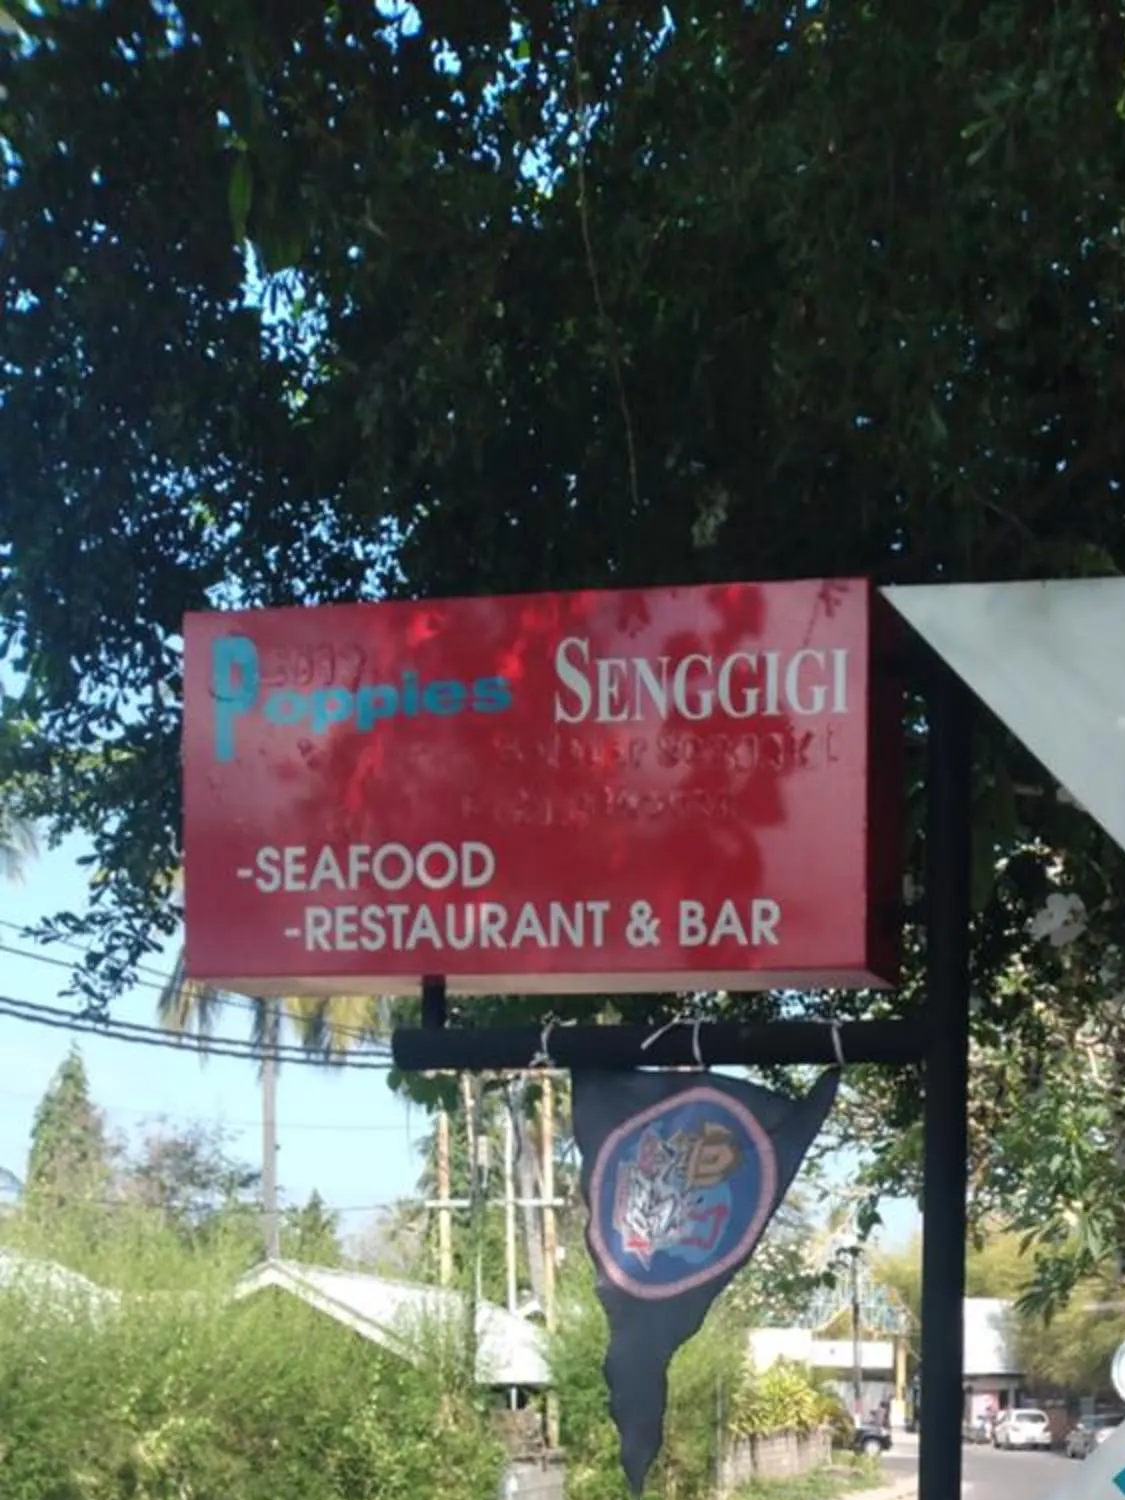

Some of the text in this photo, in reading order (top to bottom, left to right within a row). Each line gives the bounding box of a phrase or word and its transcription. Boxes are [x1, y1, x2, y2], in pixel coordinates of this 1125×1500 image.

[211, 635, 513, 762] Poppies
[554, 635, 849, 725] SENGGIGI
[236, 840, 496, 894] -SEAFOOD
[284, 899, 782, 952] -RESTAURANT & BAR
